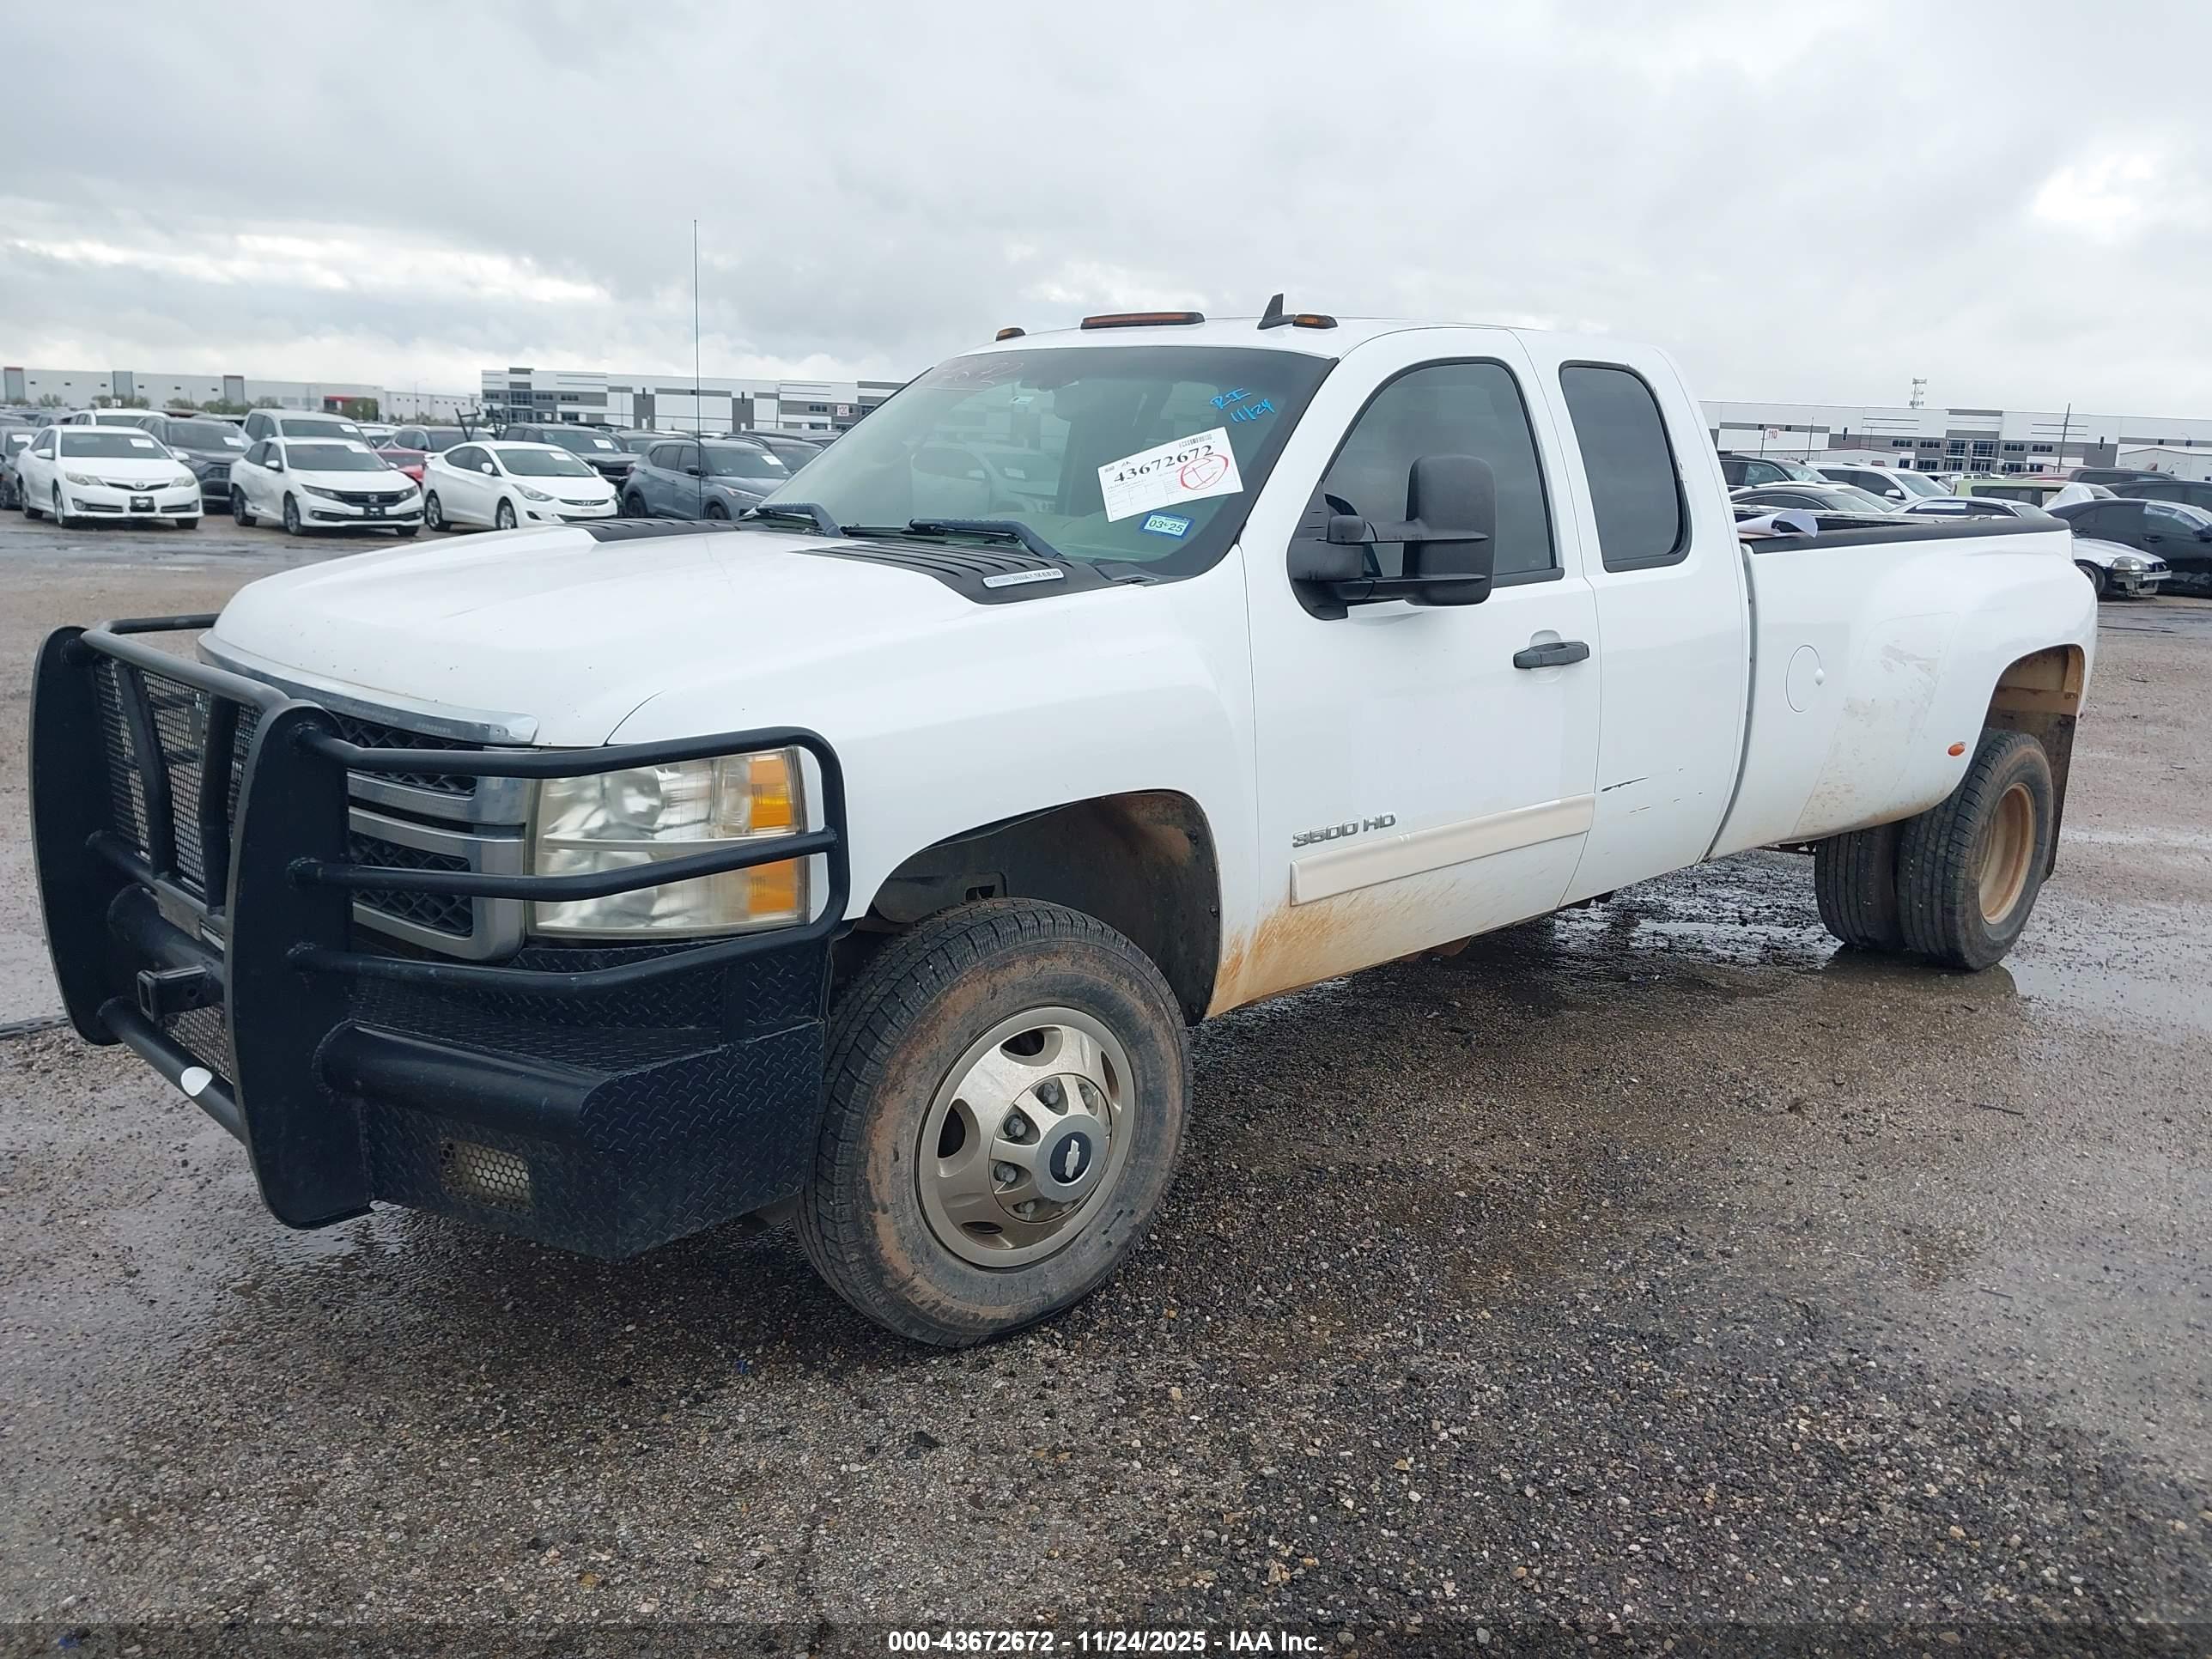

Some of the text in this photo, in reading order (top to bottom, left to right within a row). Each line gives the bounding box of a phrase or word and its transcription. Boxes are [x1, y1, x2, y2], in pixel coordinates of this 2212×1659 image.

[1230, 398, 1275, 422] 11/24
[1114, 445, 1214, 483] 43672672
[1149, 520, 1185, 532] 03 25
[1292, 814, 1396, 848] 3500 HD
